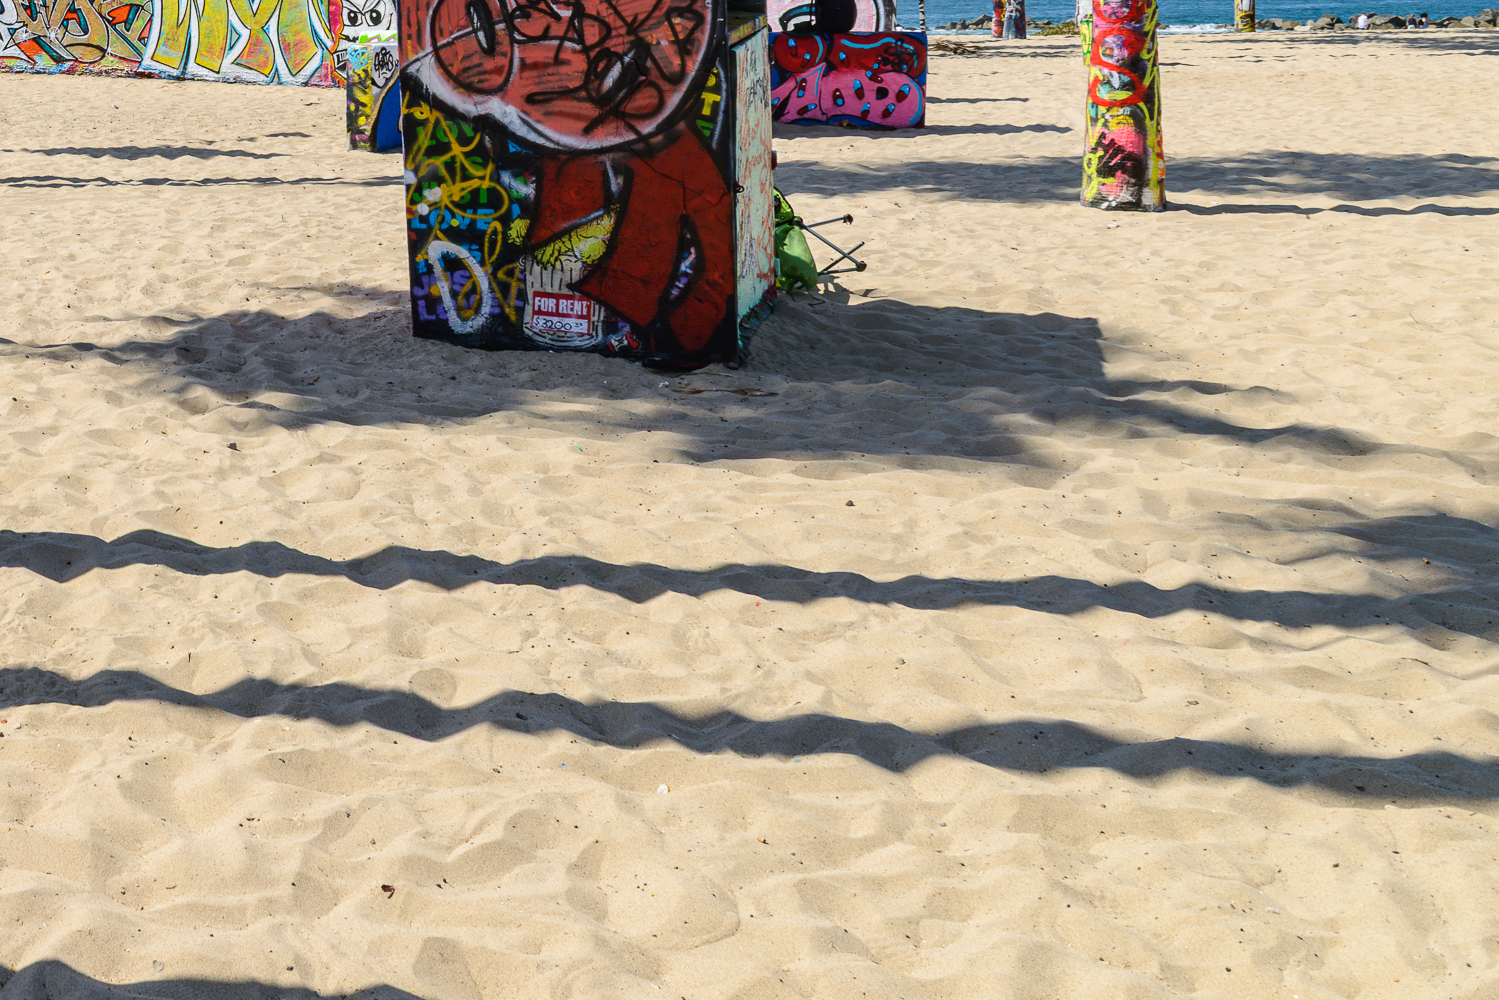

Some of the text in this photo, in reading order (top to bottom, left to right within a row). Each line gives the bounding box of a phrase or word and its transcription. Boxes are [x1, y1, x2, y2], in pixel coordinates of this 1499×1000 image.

[415, 118, 476, 147] LOV
[411, 207, 495, 230] LOVE
[534, 296, 589, 316] FOR RENT
